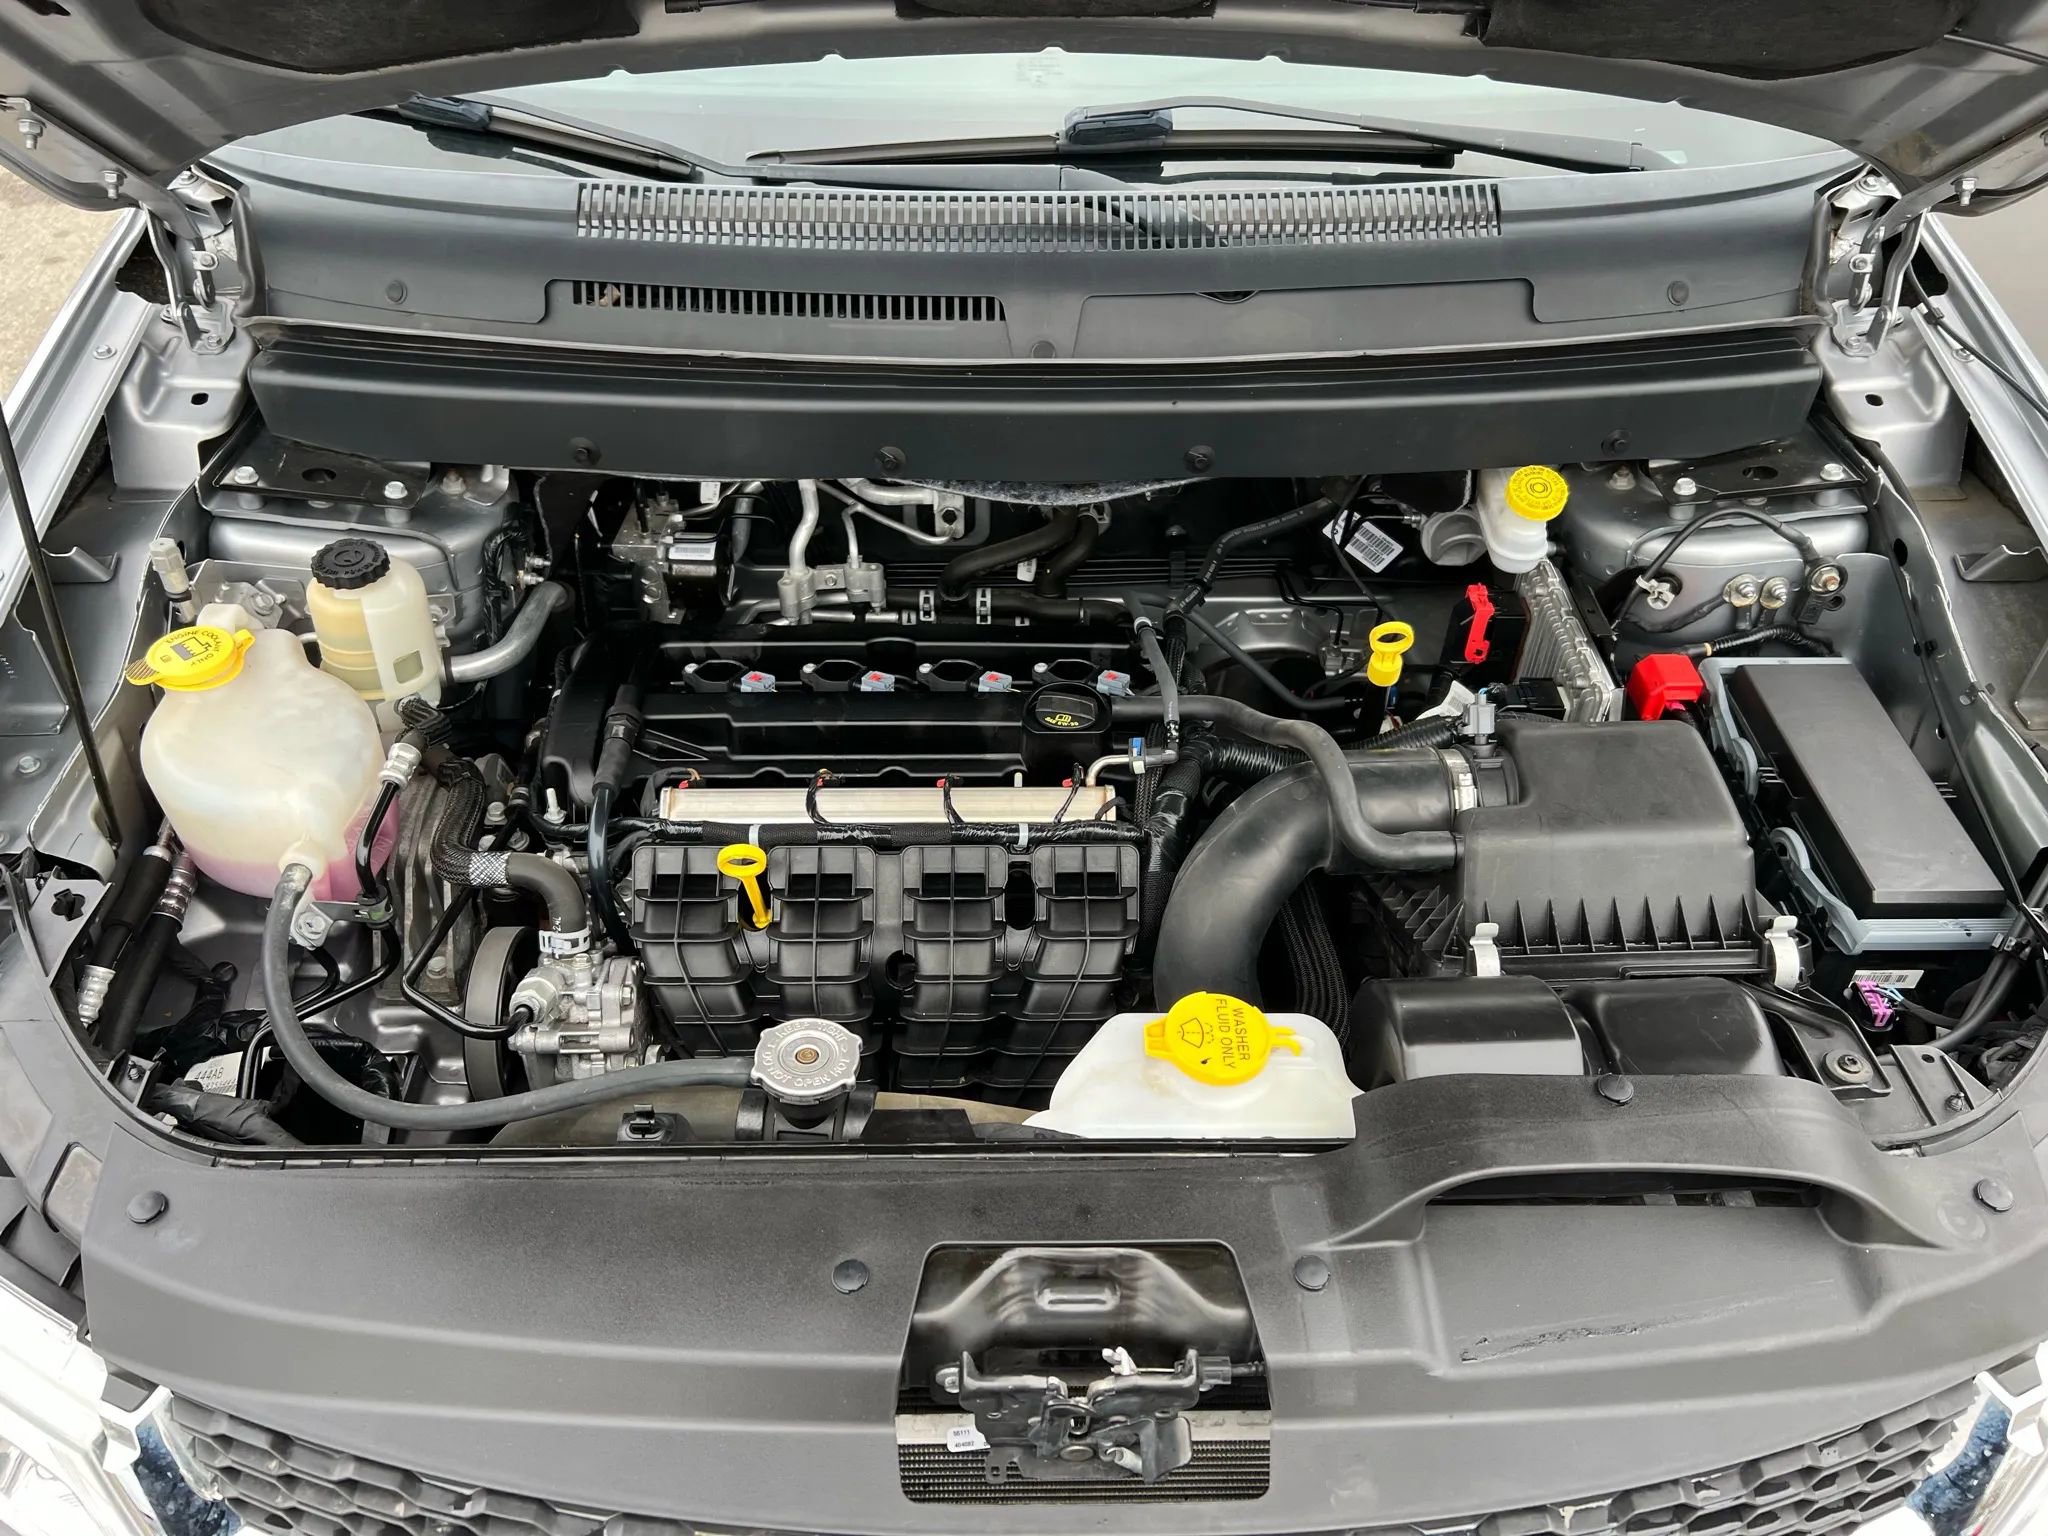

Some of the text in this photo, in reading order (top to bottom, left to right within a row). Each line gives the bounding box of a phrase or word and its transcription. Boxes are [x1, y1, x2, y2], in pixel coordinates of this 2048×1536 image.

[165, 629, 198, 644] ENGINE
[775, 1021, 848, 1042] KEEP TIGHT
[1215, 998, 1237, 1069] FLUID ONLY
[1232, 1007, 1251, 1062] WASHER
[766, 1066, 792, 1084] NOT
[793, 1075, 831, 1088] OPEN
[829, 1058, 851, 1077] HOT
